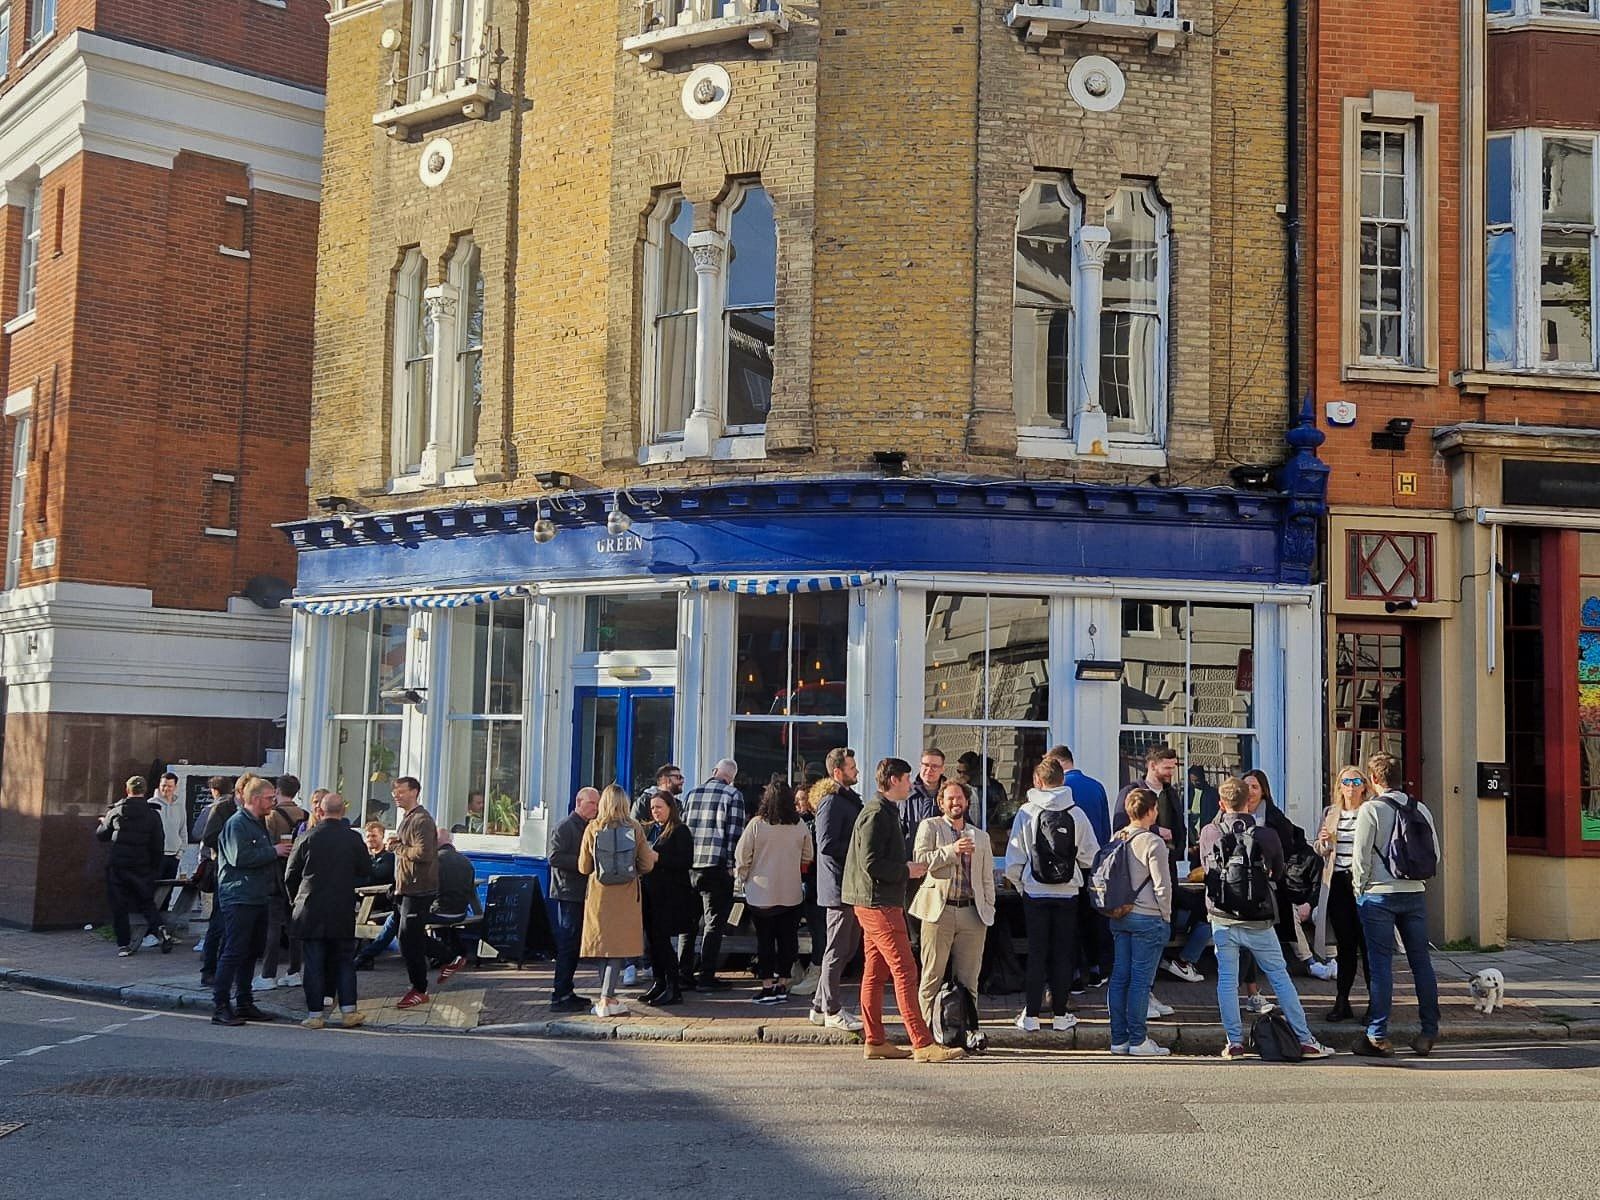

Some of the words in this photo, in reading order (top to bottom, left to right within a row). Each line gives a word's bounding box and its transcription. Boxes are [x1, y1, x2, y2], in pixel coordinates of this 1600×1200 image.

[1400, 474, 1415, 492] H
[597, 536, 643, 553] GREEN
[1487, 779, 1498, 790] 30
